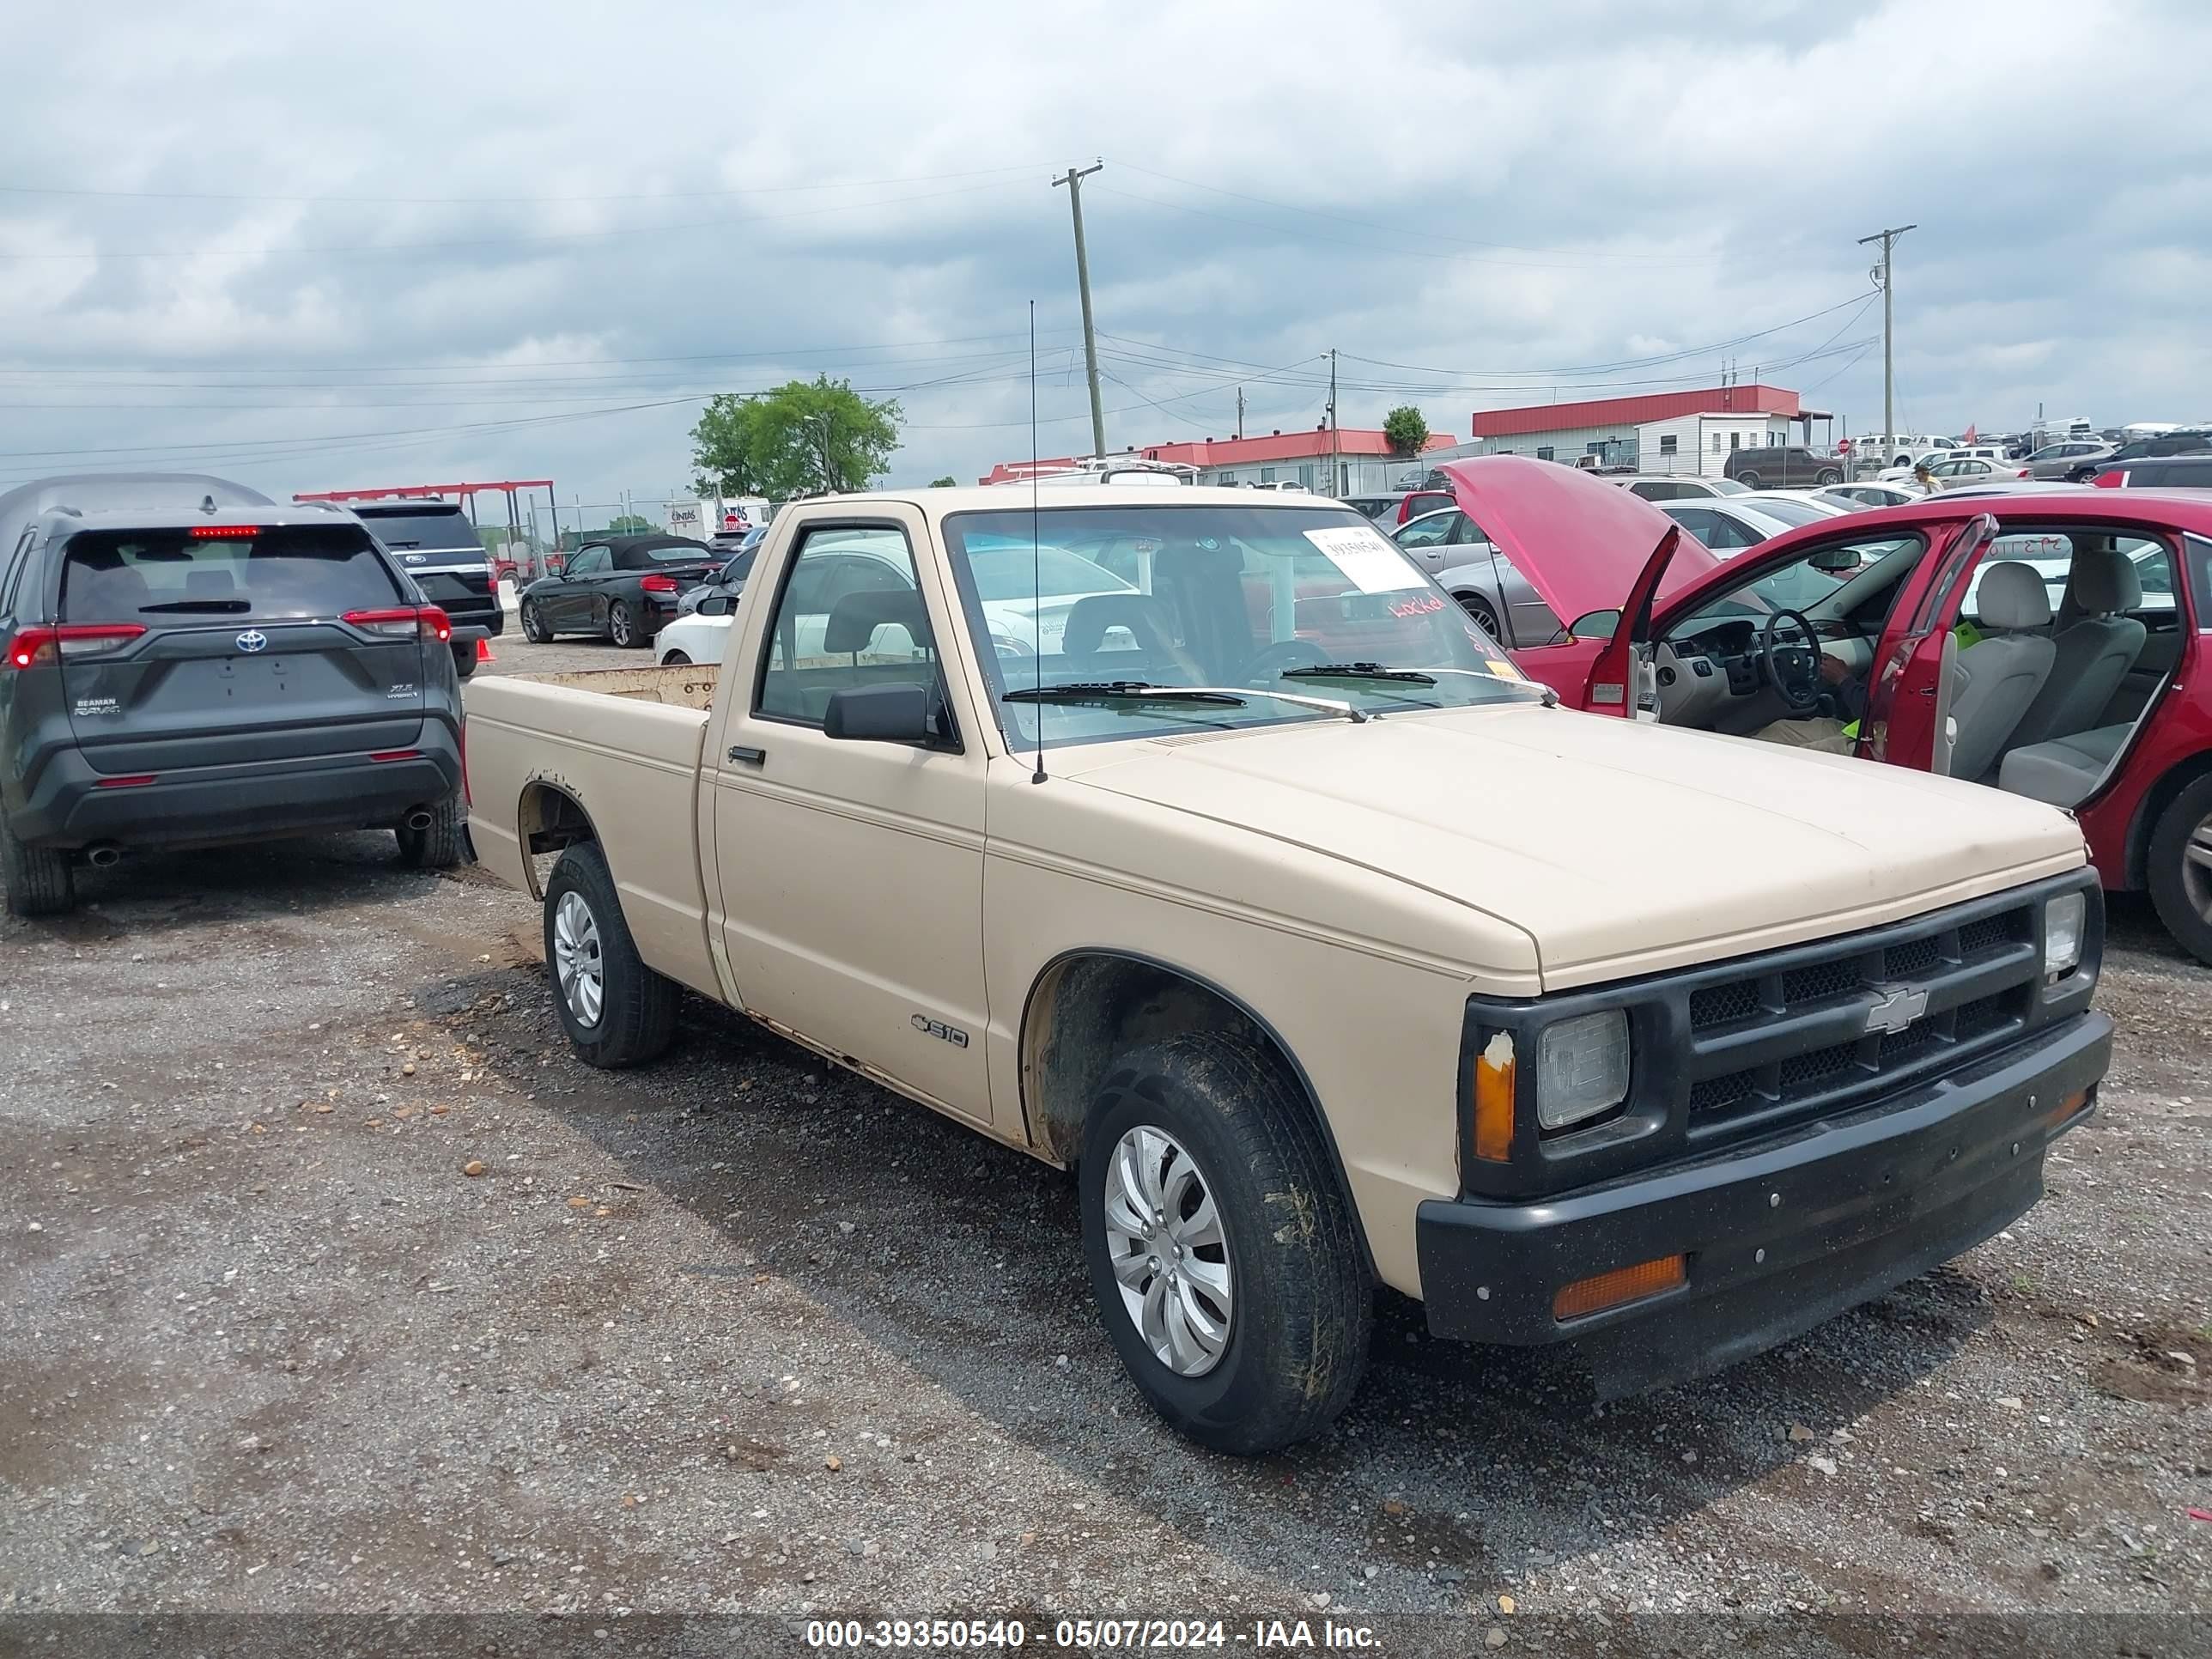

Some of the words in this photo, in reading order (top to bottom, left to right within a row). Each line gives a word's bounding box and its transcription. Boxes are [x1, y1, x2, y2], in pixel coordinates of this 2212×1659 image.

[672, 508, 696, 521] CINTAS
[725, 521, 739, 530] STOP
[77, 698, 116, 707] BEAMAN
